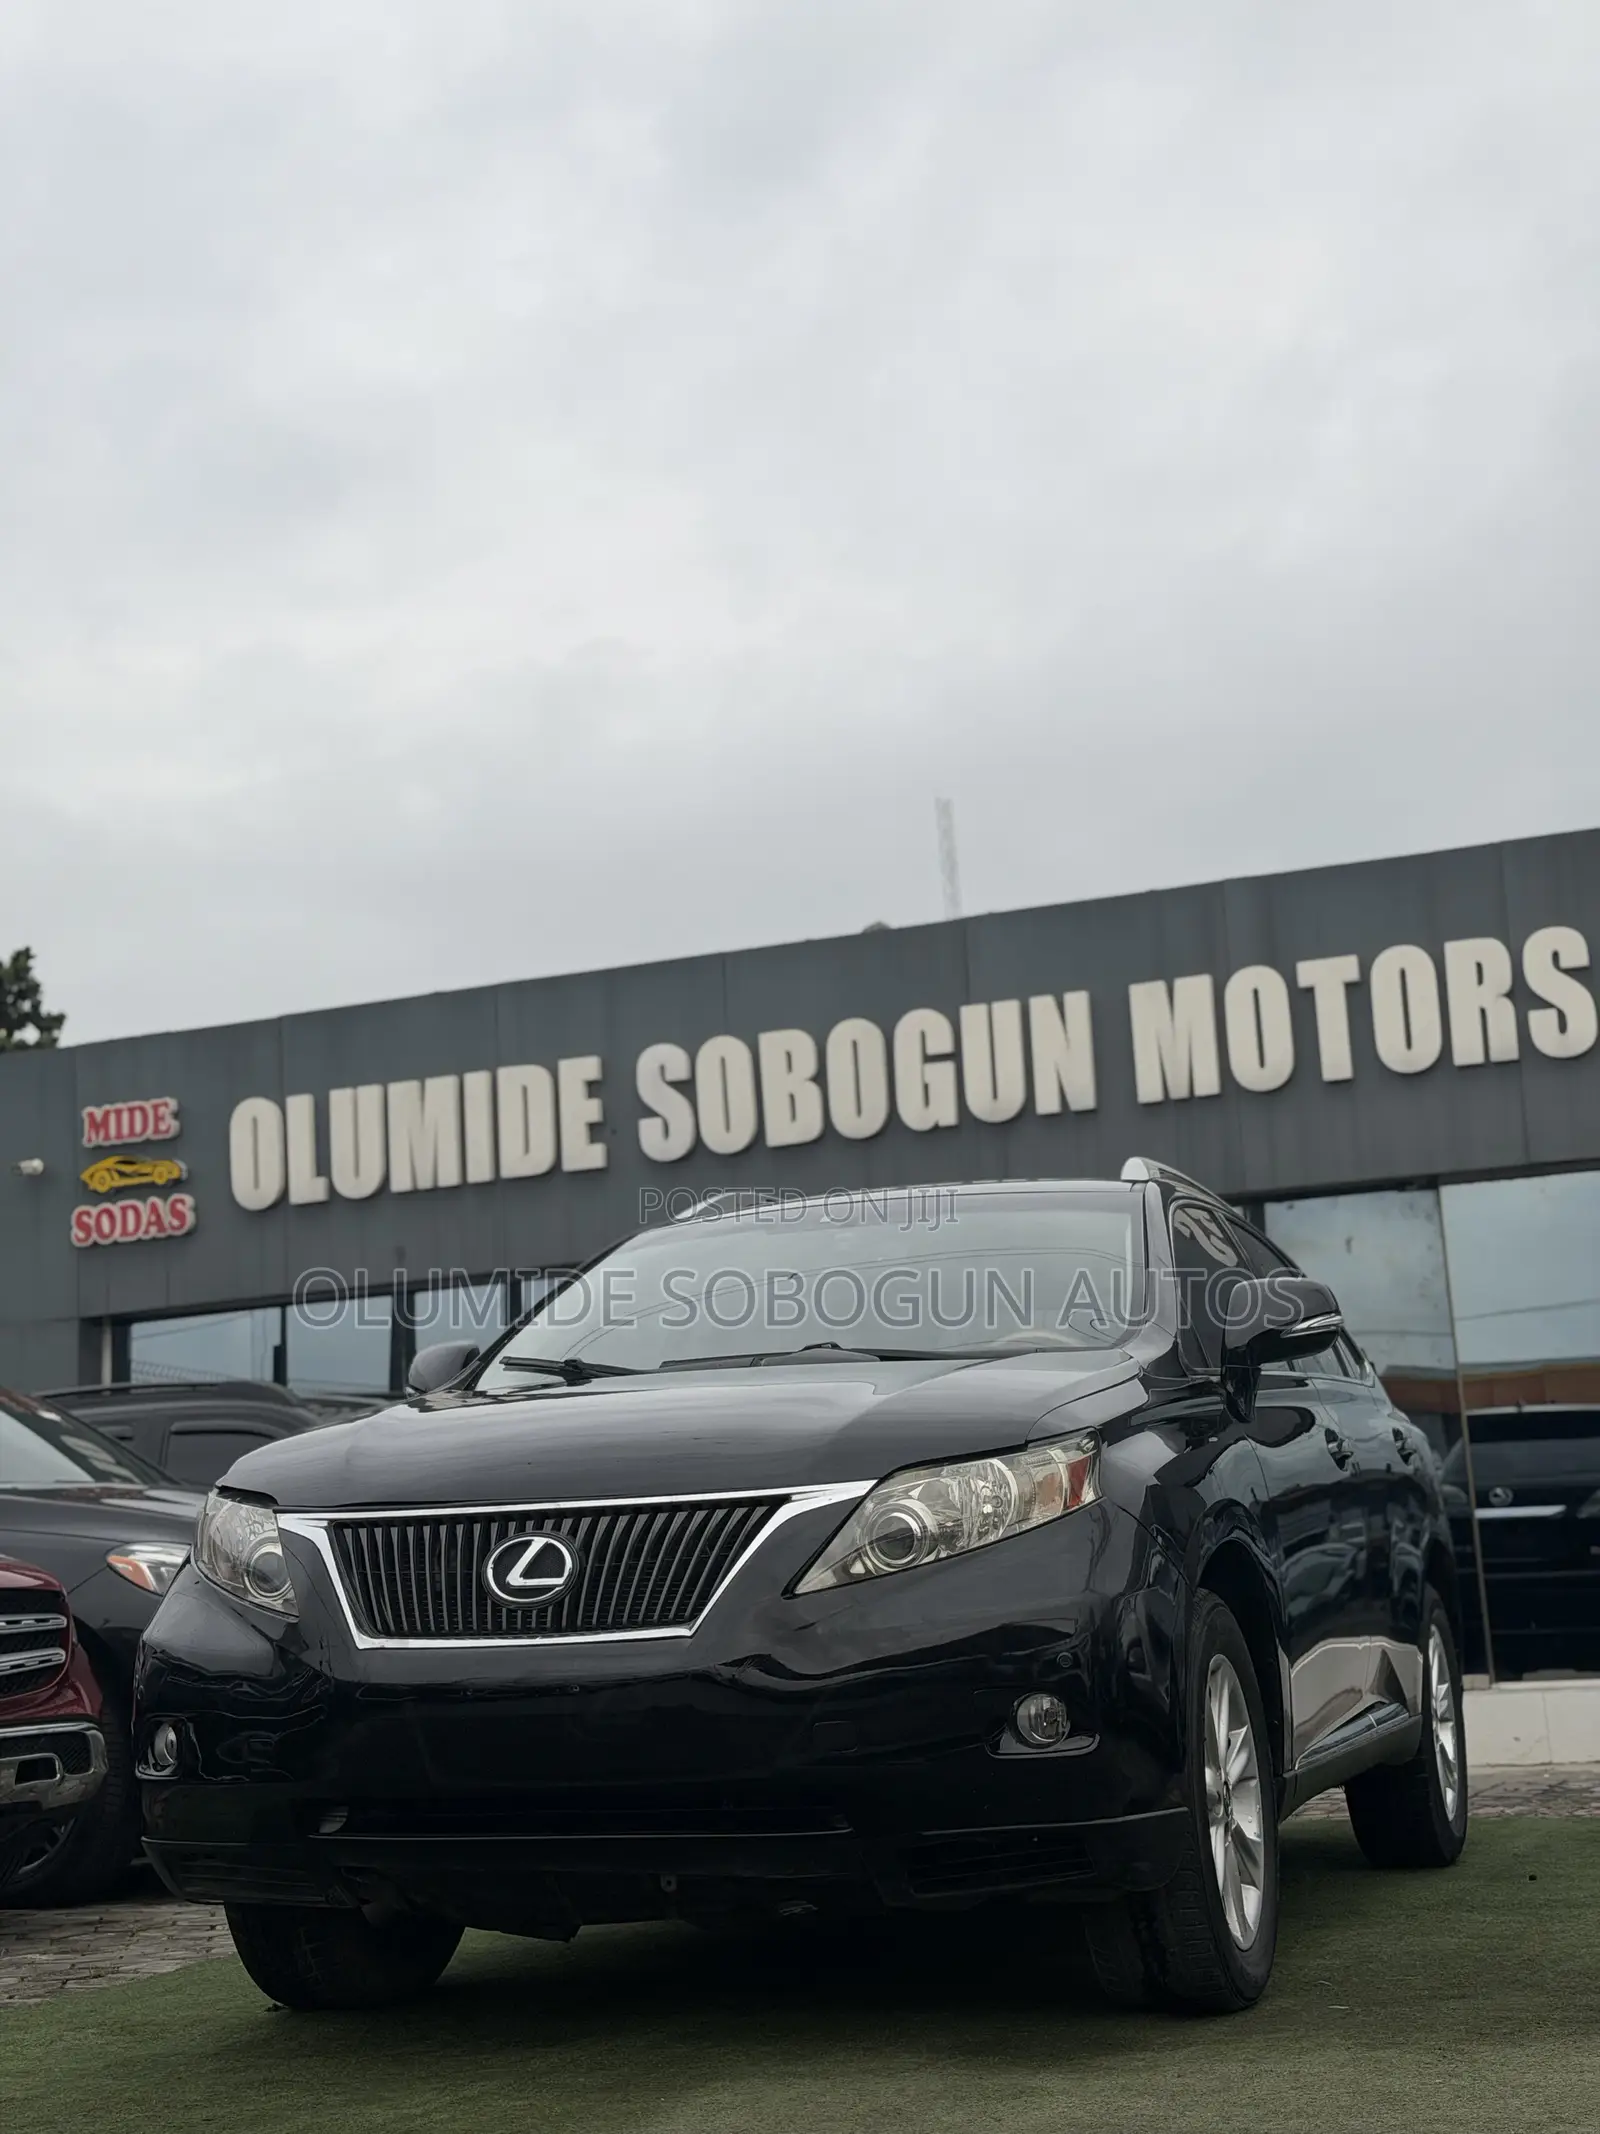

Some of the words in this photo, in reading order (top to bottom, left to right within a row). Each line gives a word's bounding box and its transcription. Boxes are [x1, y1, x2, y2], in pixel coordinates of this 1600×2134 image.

[230, 1055, 607, 1211] OLUMIDE
[636, 990, 1097, 1162] SOBOGUN
[1129, 926, 1598, 1104] MOTORS
[83, 1097, 180, 1147] MIDE
[71, 1194, 195, 1246] SODAS
